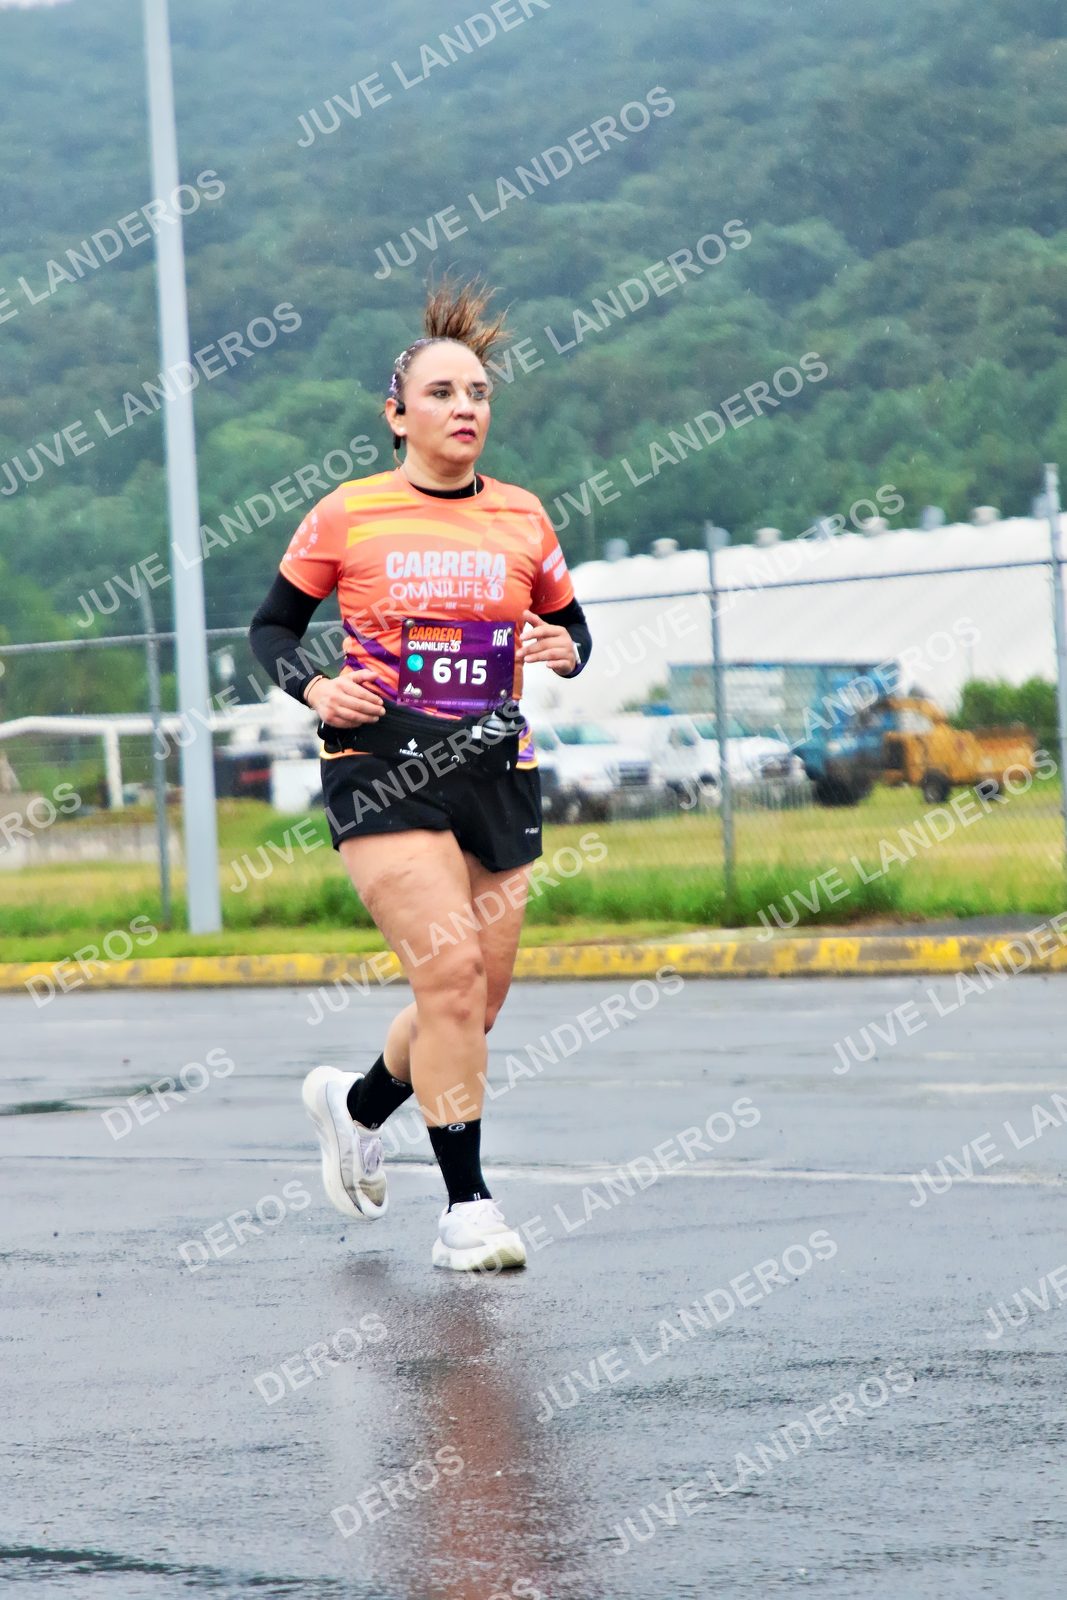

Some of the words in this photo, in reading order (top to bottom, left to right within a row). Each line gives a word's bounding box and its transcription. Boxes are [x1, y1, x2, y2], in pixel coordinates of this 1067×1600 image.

[386, 551, 506, 580] CARRERA
[389, 581, 483, 601] OMNILIFE
[408, 626, 463, 641] CARRERA
[407, 640, 450, 652] OMNILIFE
[432, 657, 488, 685] 615
